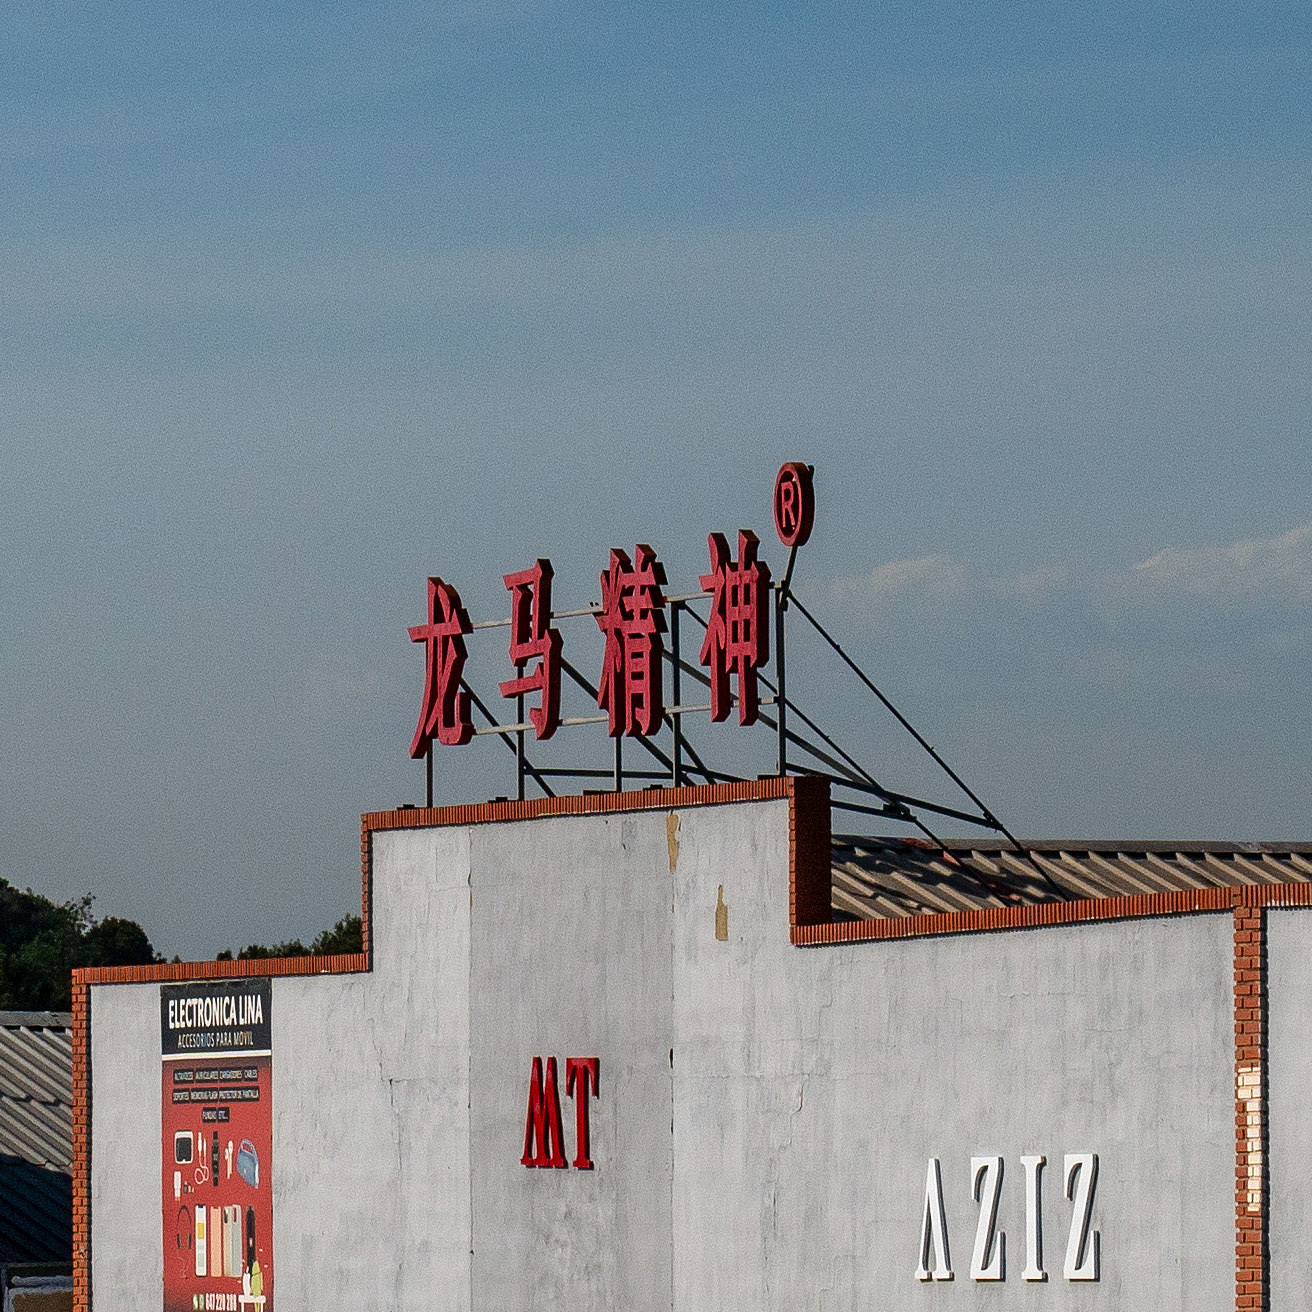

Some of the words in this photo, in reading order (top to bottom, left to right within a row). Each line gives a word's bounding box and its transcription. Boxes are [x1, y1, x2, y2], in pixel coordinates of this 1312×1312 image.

[407, 529, 770, 759] 龙马精神
[169, 996, 237, 1029] ELECTRONICA
[239, 995, 263, 1025] LINA
[521, 1055, 600, 1170] MT
